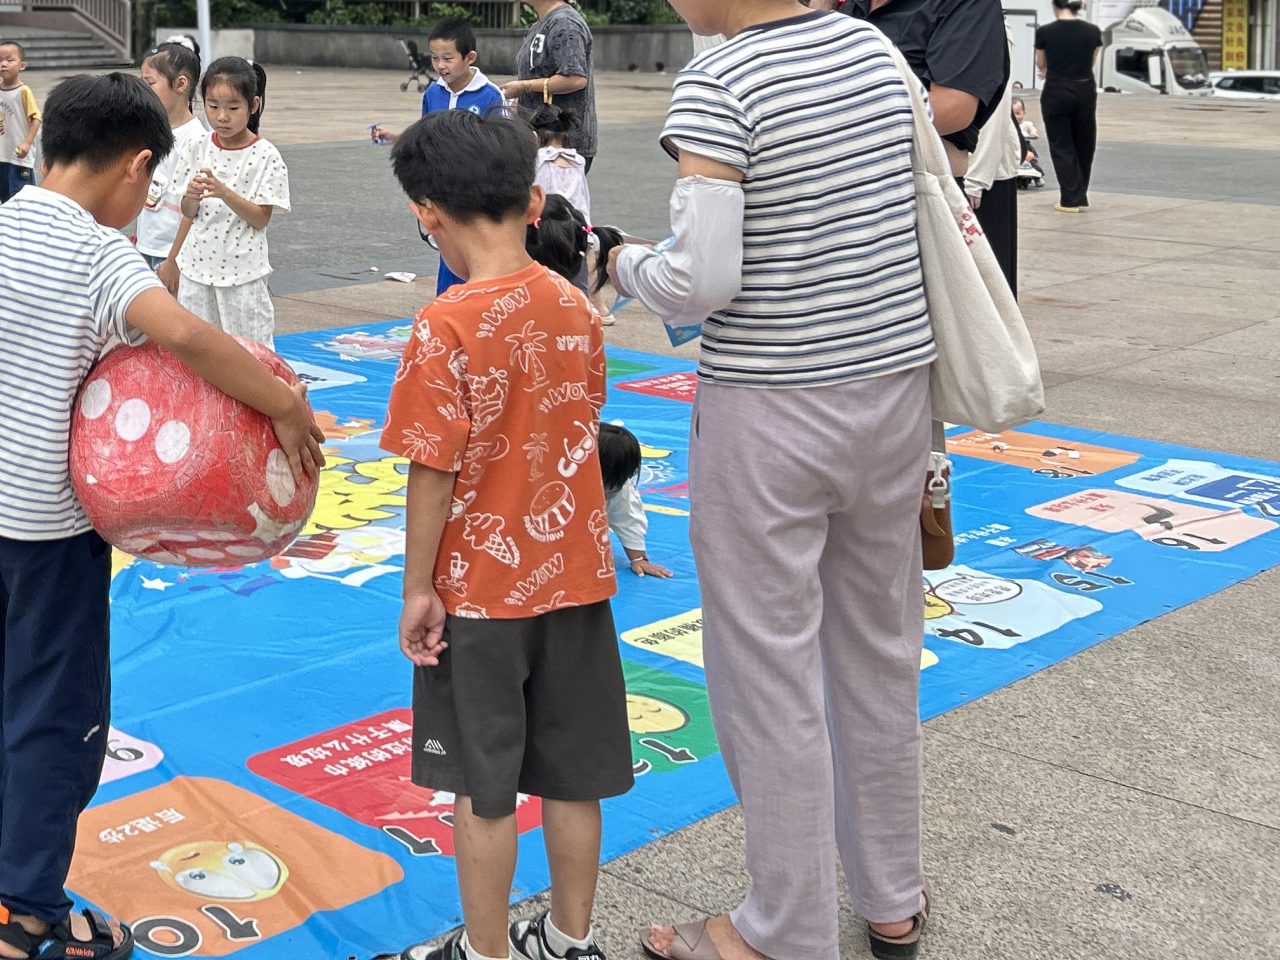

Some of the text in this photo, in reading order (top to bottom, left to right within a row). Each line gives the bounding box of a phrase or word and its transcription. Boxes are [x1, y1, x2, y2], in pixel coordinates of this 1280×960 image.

[280, 718, 413, 768] 属于什么垃圾
[98, 807, 186, 844] 后退2步
